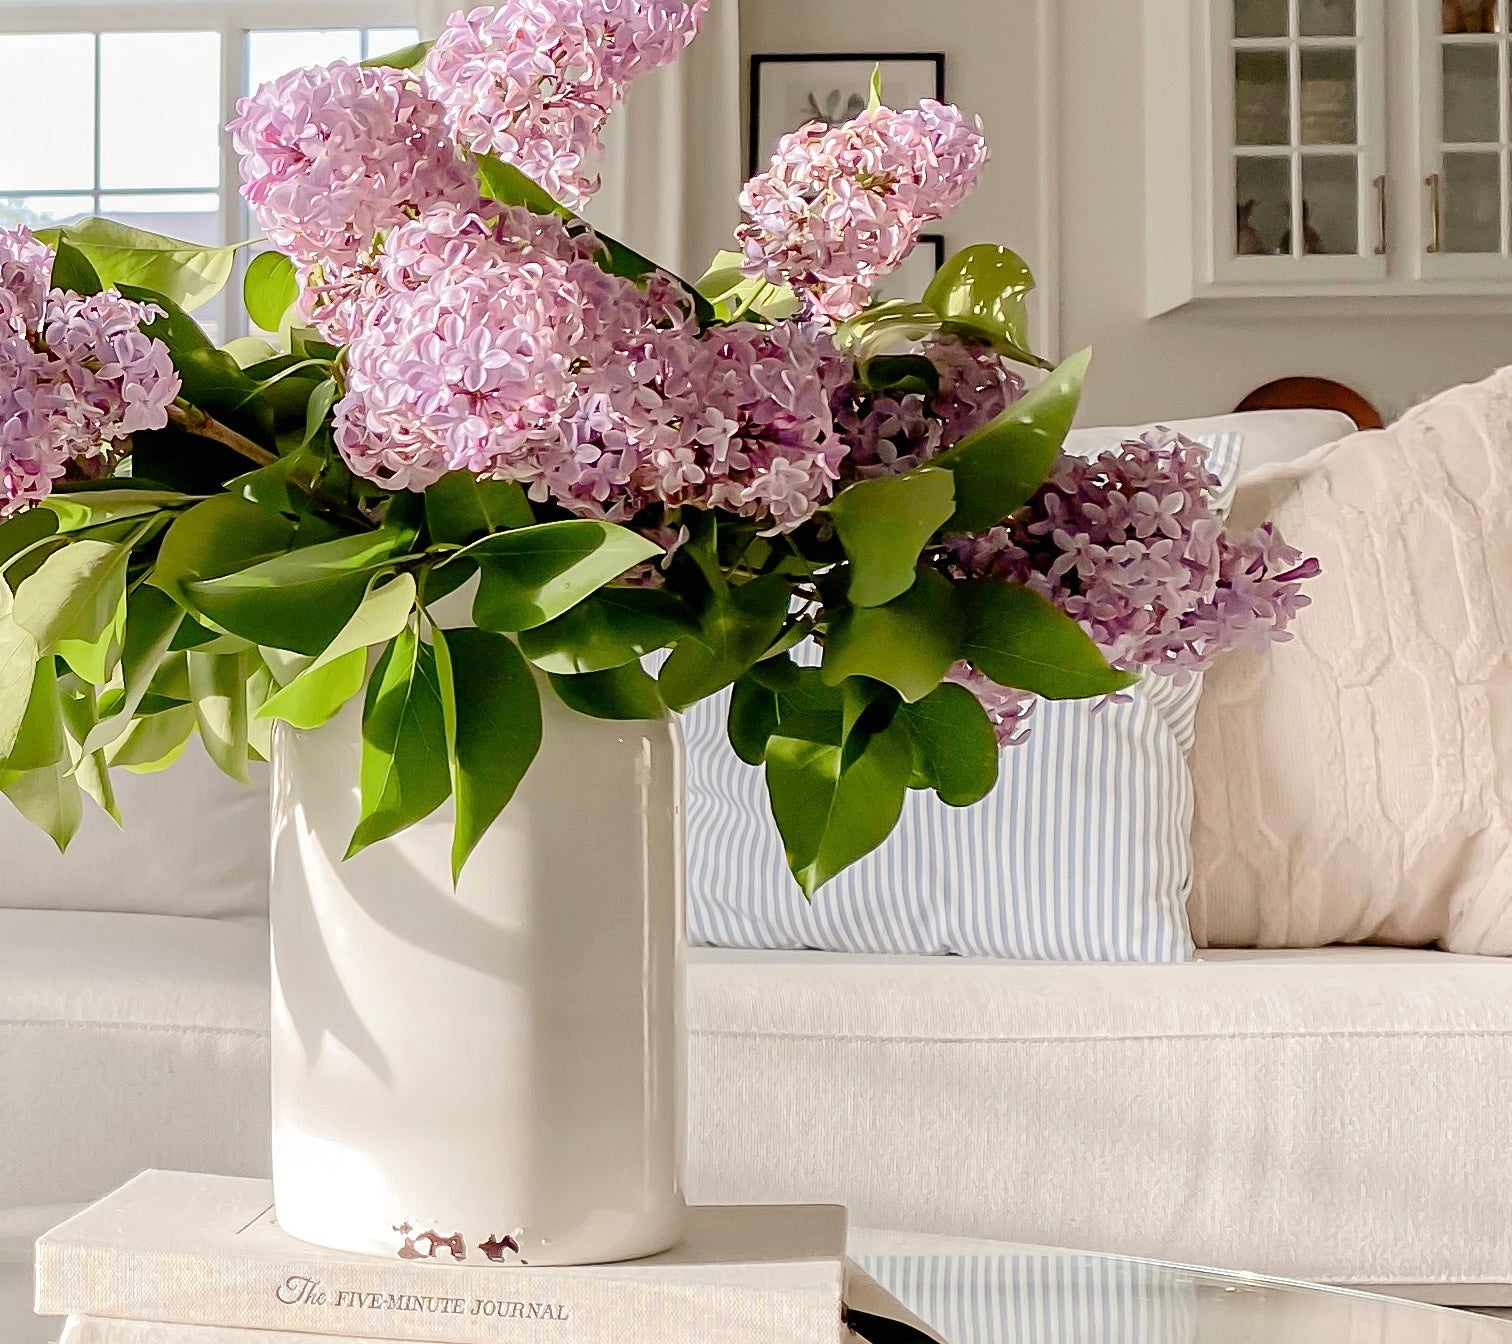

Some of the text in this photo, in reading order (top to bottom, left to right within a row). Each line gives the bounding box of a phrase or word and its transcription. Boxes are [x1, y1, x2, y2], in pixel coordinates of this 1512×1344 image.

[276, 1275, 570, 1321] The FIVE-MINUTE JOURNAL
